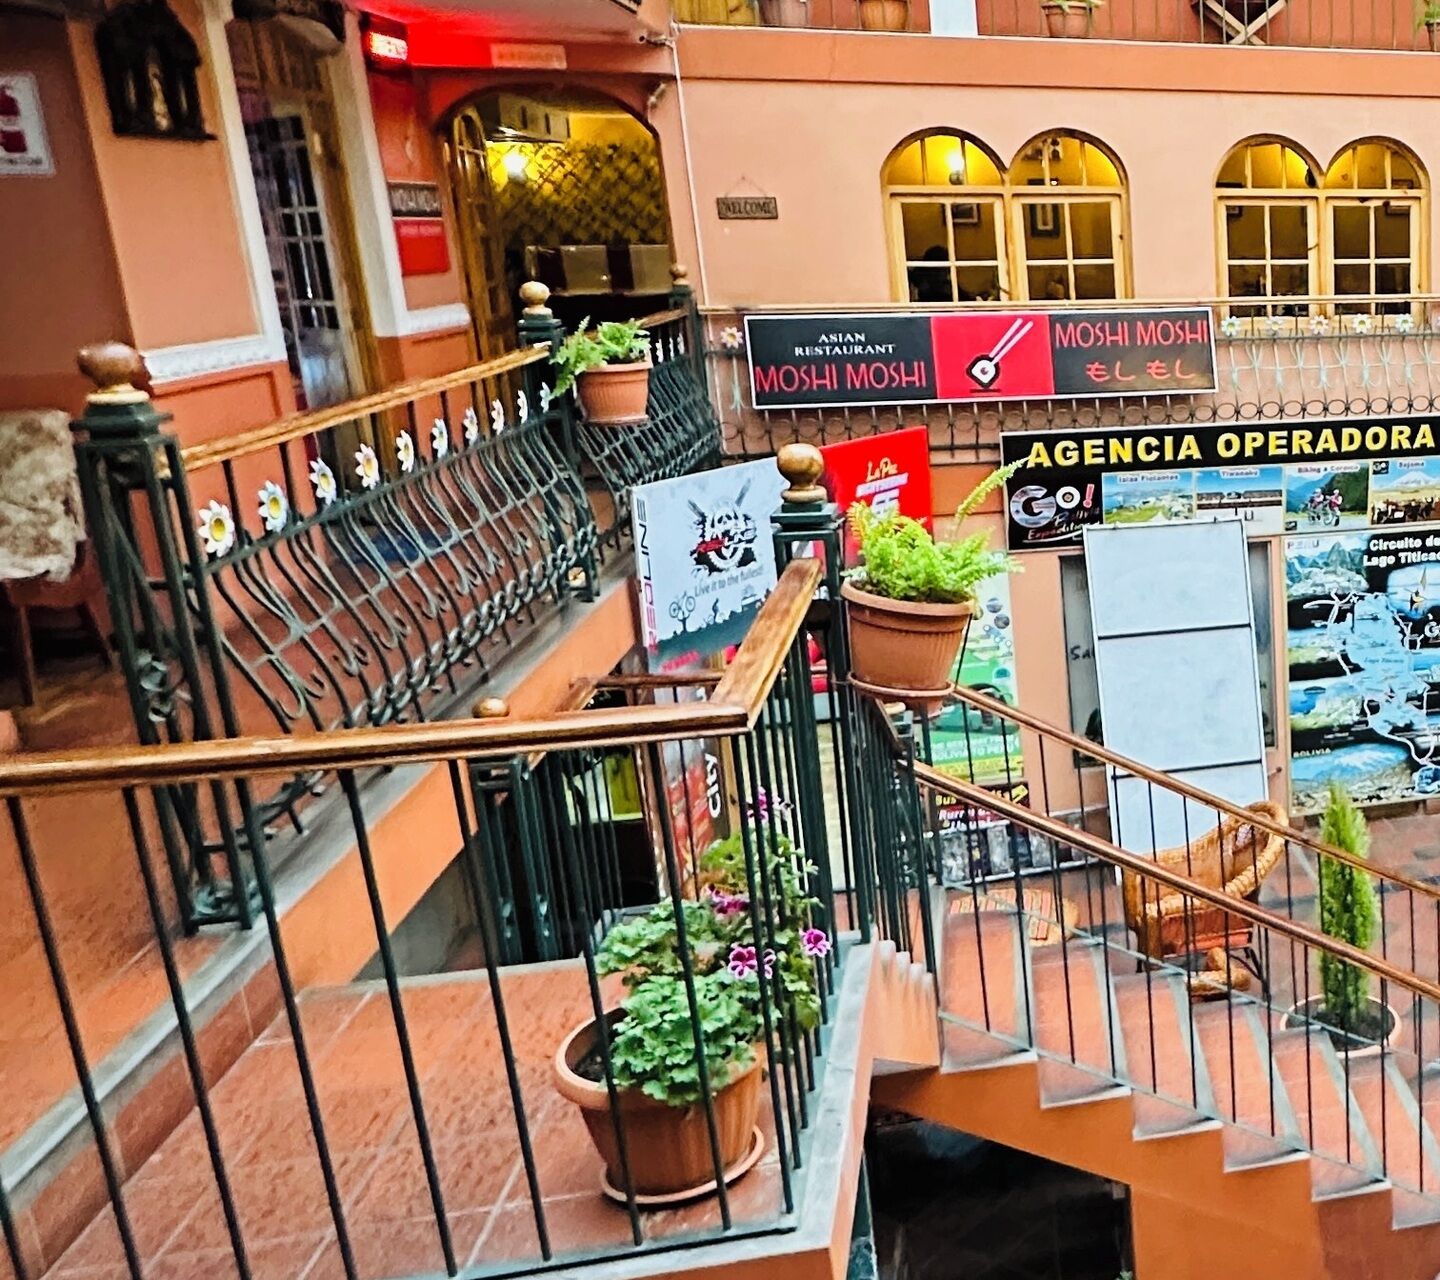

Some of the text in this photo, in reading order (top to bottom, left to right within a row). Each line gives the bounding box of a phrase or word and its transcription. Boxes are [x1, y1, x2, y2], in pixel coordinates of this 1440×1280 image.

[819, 333, 866, 344] ASIAN
[1055, 320, 1207, 348] MOSHI MOSHI
[794, 344, 895, 356] RESTAURANT
[755, 360, 926, 393] MOSHI MOSHI
[1027, 423, 1436, 469] AGENCIA OPERADORA
[1370, 537, 1423, 551] Circuito
[1363, 554, 1396, 568] Lago
[704, 753, 722, 818] City
